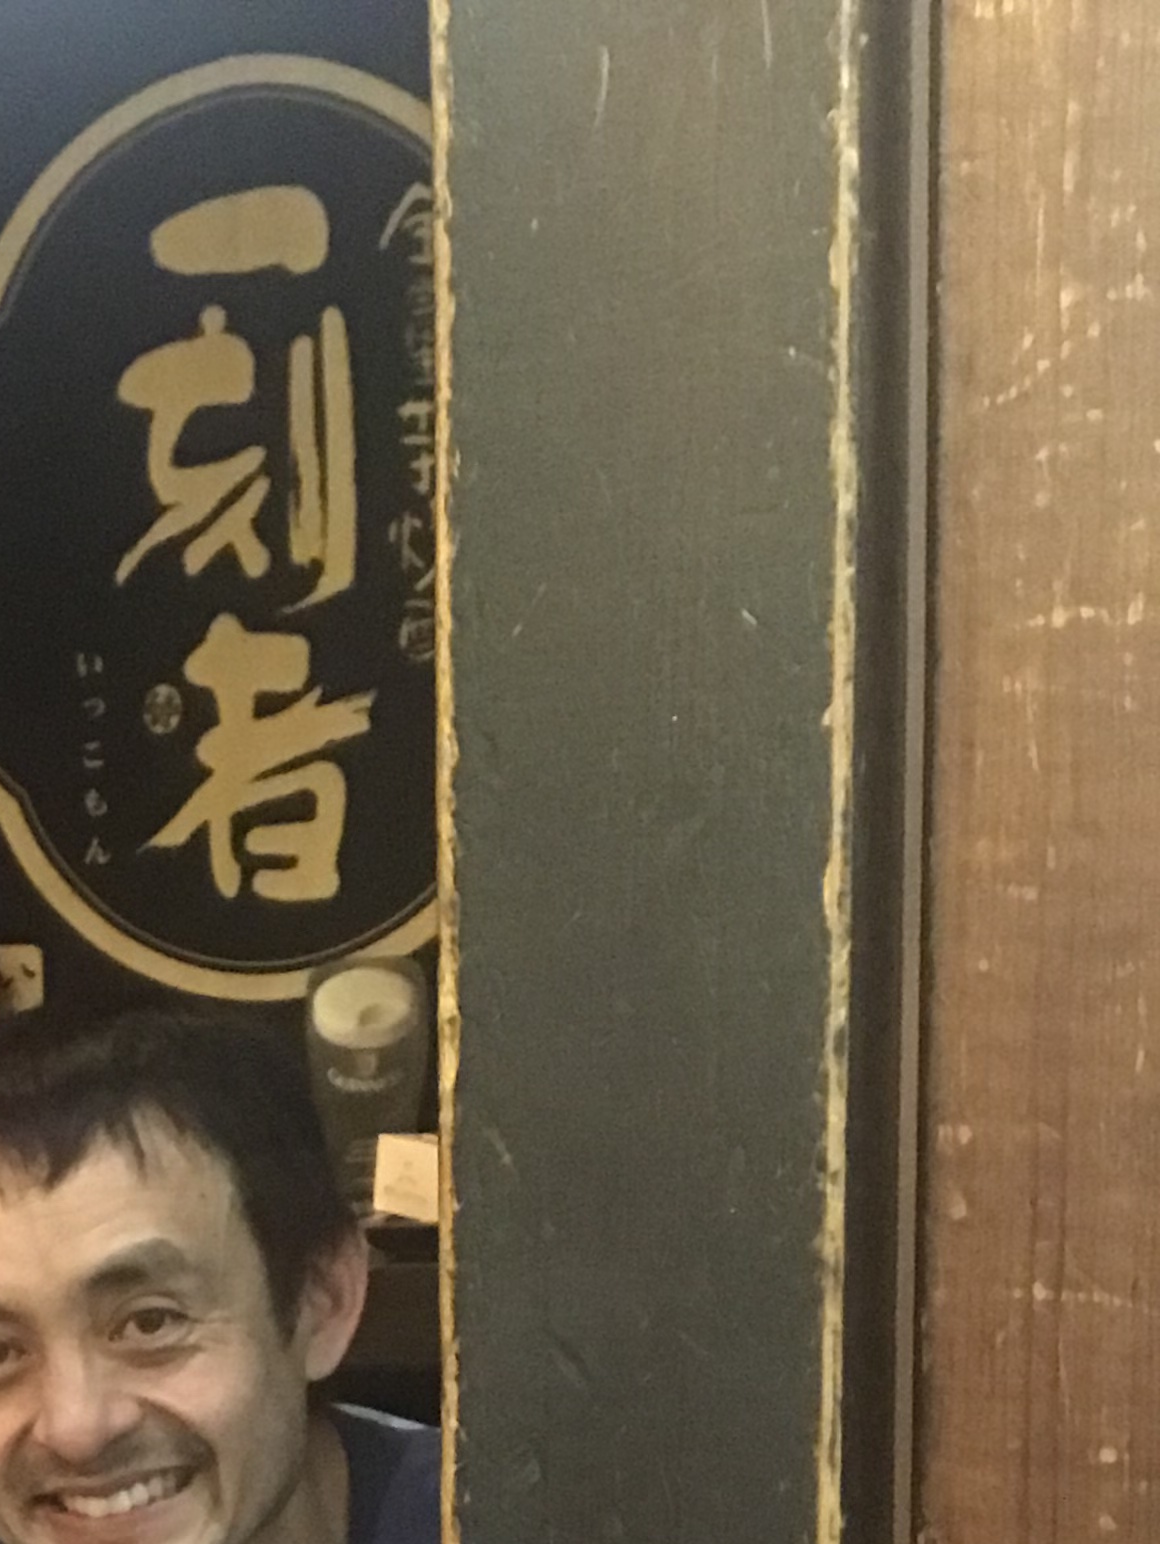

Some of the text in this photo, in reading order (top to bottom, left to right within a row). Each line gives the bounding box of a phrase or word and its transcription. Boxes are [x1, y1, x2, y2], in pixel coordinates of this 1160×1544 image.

[75, 652, 112, 866] いっこもん
[117, 184, 377, 901] 一刻者
